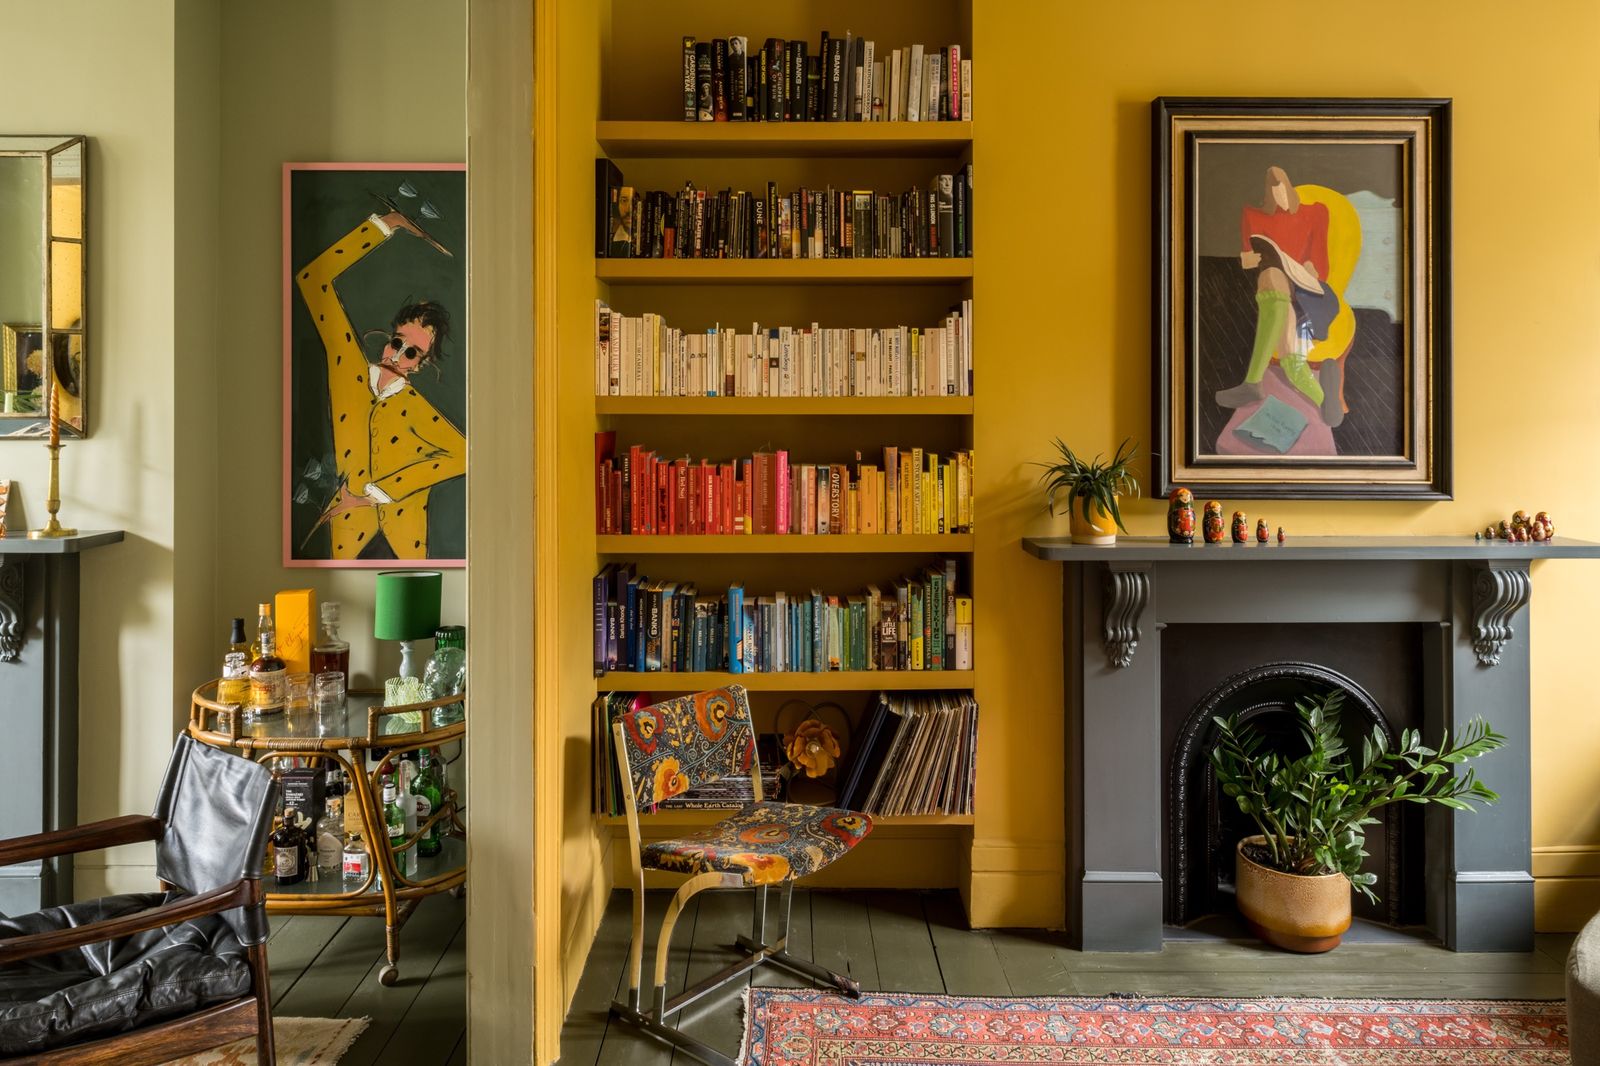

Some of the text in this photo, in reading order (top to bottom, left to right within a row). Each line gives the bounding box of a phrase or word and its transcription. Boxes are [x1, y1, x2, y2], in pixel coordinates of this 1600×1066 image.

[831, 472, 840, 519] OVERSTORY
[882, 628, 896, 636] LIFE
[721, 801, 744, 809] Catalog
